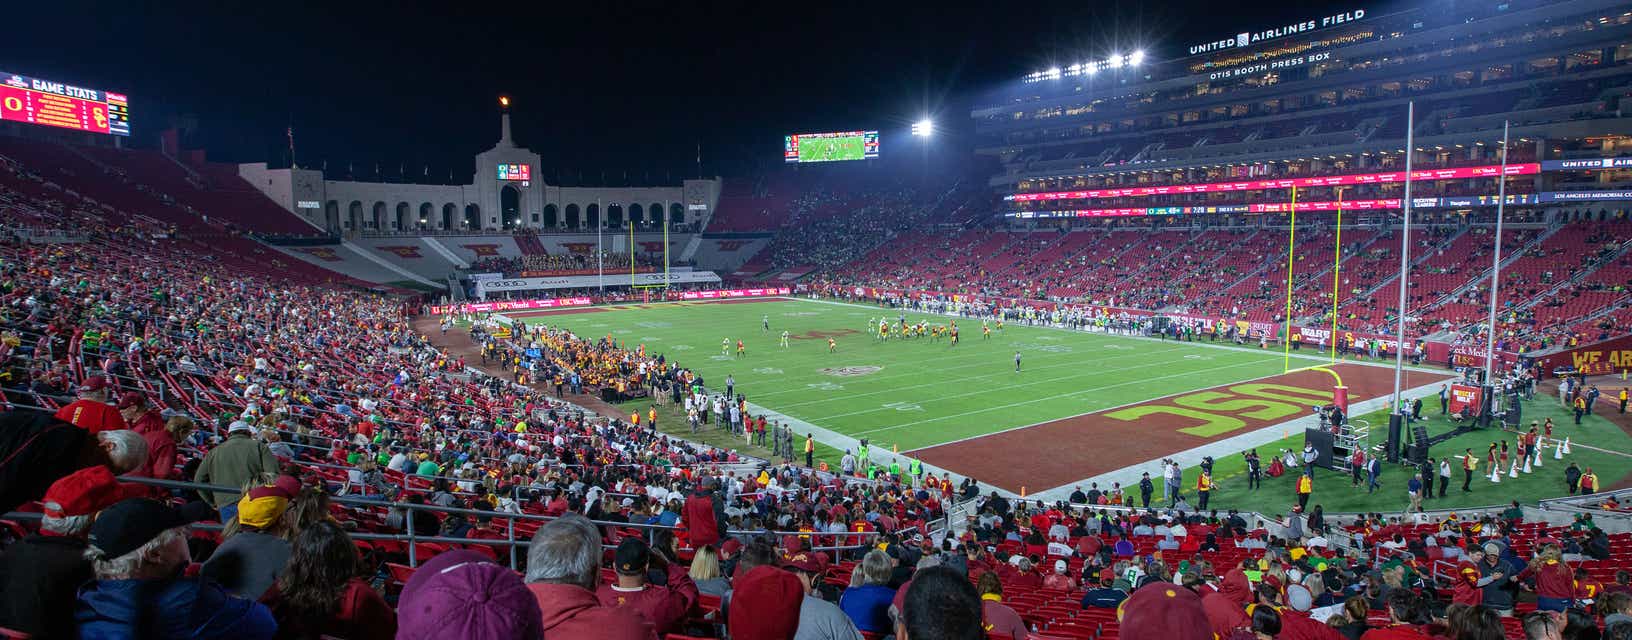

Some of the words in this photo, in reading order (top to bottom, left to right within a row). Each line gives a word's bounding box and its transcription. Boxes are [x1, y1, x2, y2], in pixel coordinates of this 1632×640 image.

[1190, 39, 1234, 54] UNITED
[1251, 20, 1316, 42] AIRLINES
[1322, 9, 1365, 27] FIELD
[1210, 70, 1231, 80] OTIS
[1234, 64, 1267, 76] BOOTH
[1271, 57, 1304, 69] PRESS
[1308, 52, 1330, 62] BOX
[32, 79, 64, 95] GAME
[65, 86, 98, 100] STATS
[1571, 351, 1602, 369] WE
